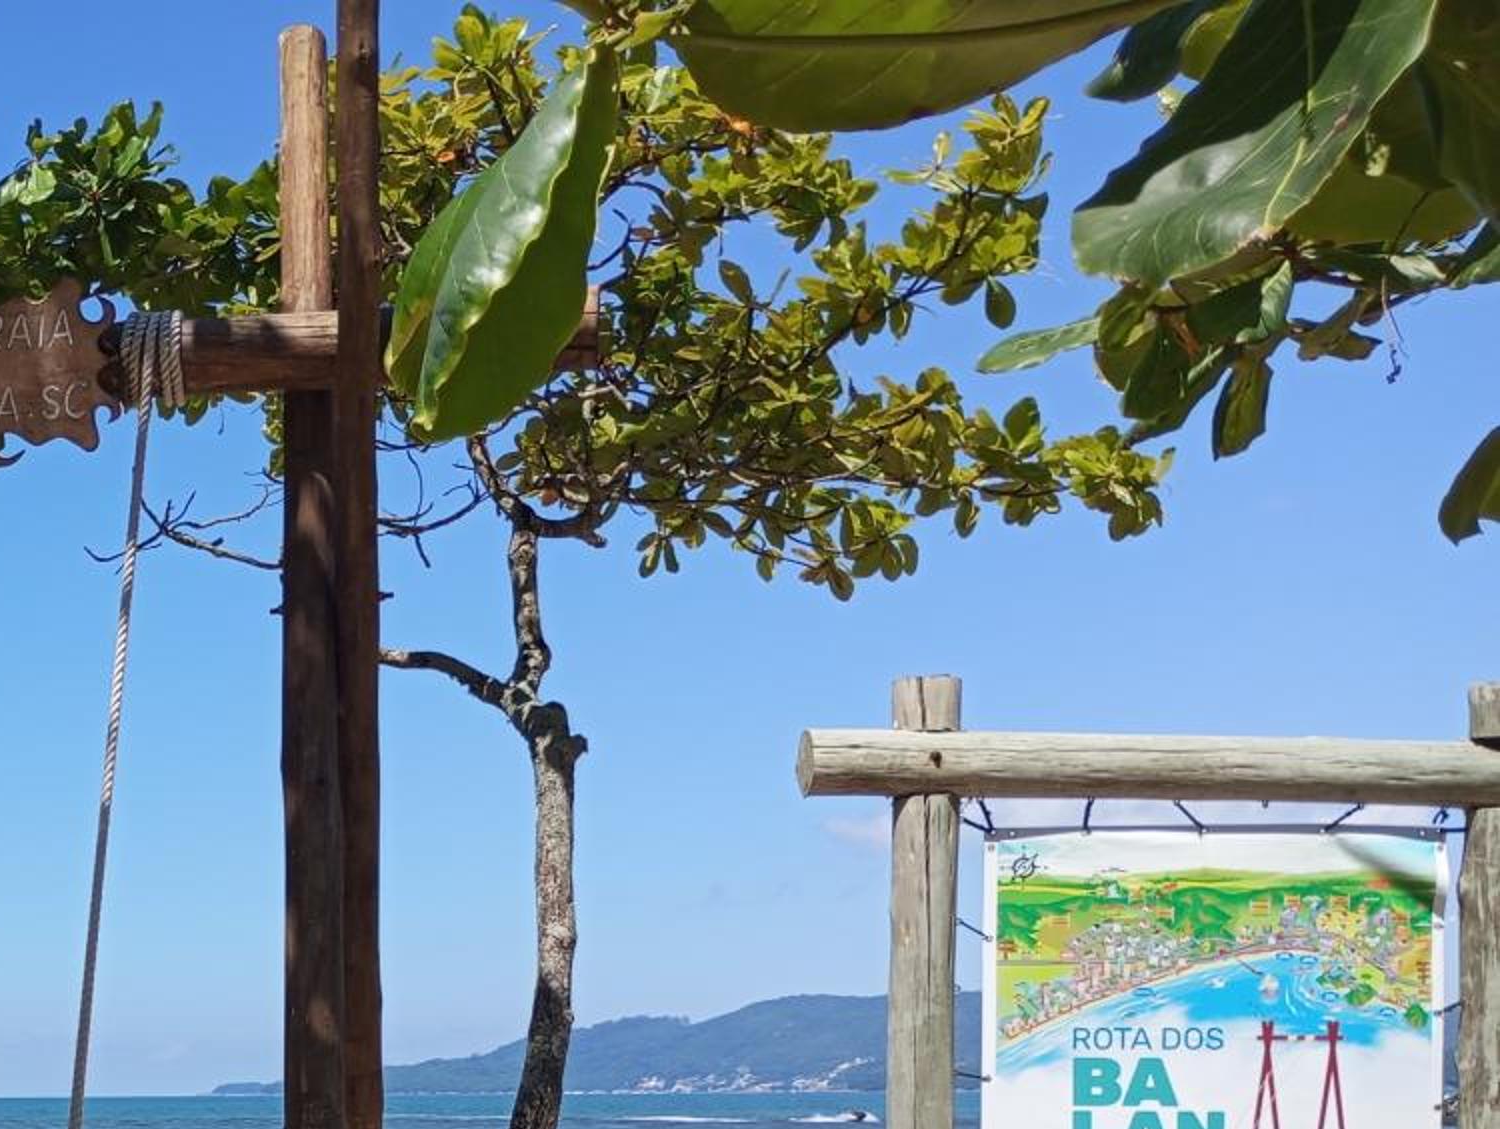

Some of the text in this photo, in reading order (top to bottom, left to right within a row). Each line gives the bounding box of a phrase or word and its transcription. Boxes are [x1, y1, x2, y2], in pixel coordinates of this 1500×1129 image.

[1072, 1027, 1225, 1051] ROTA DOS
[1071, 1057, 1179, 1107] BA
